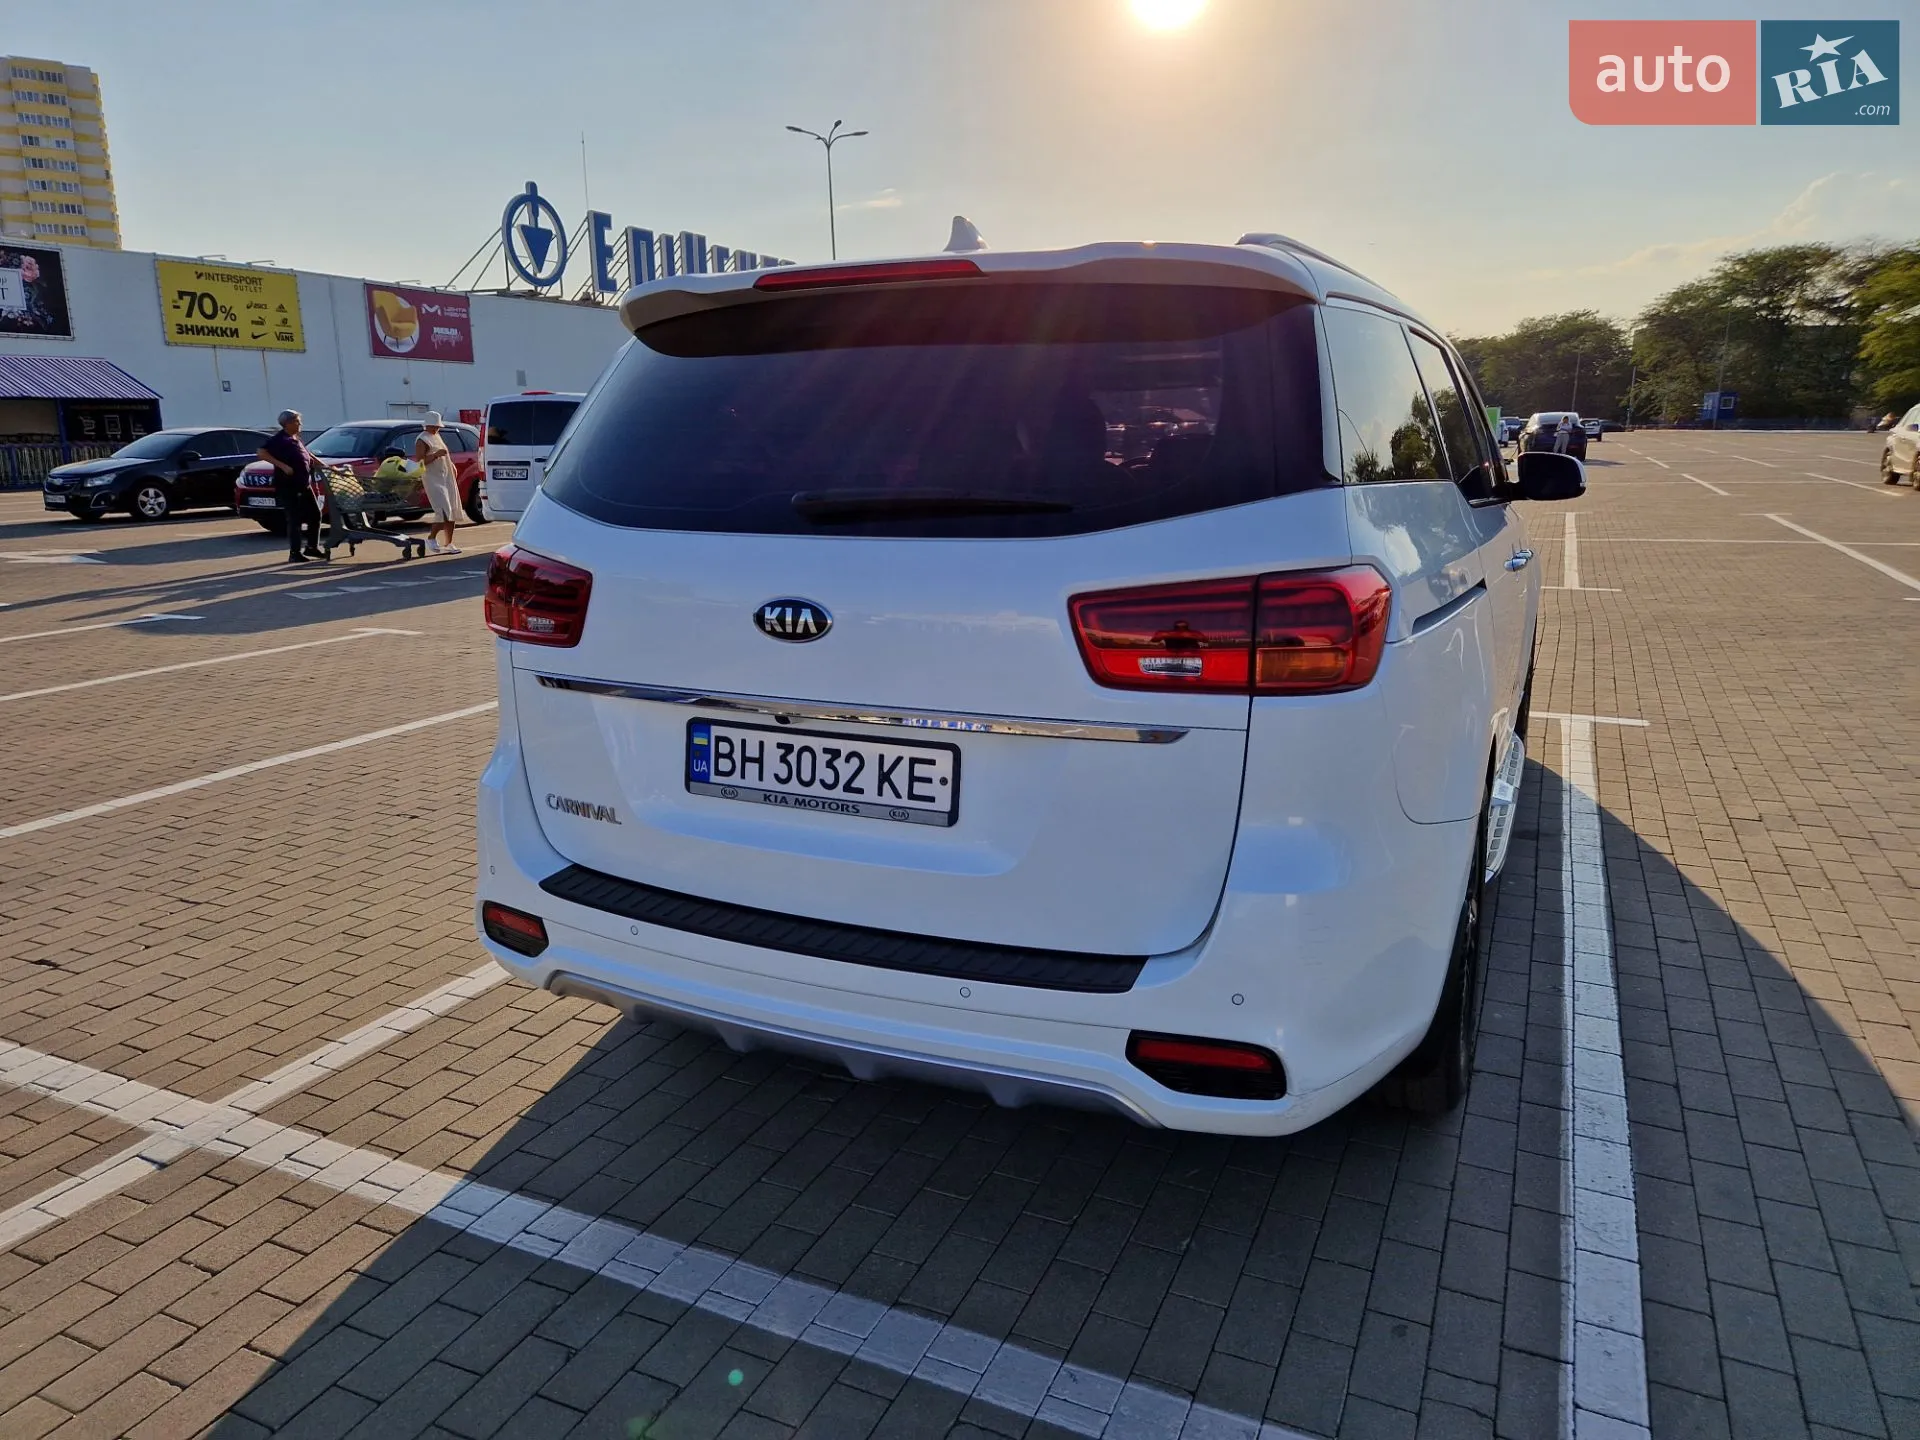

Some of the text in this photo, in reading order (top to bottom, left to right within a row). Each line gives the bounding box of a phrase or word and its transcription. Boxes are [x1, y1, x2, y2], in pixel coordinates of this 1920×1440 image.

[204, 271, 264, 286] INTERSPORT
[233, 284, 263, 293] OUTLET
[175, 323, 240, 339] ЗНИЖКИ
[764, 606, 818, 634] KIA
[693, 759, 708, 773] UA
[713, 735, 937, 804] BH 3032 KE
[545, 793, 622, 825] CARNIVAL
[763, 793, 860, 814] KIA MOTORS
[892, 809, 906, 819] KIA
